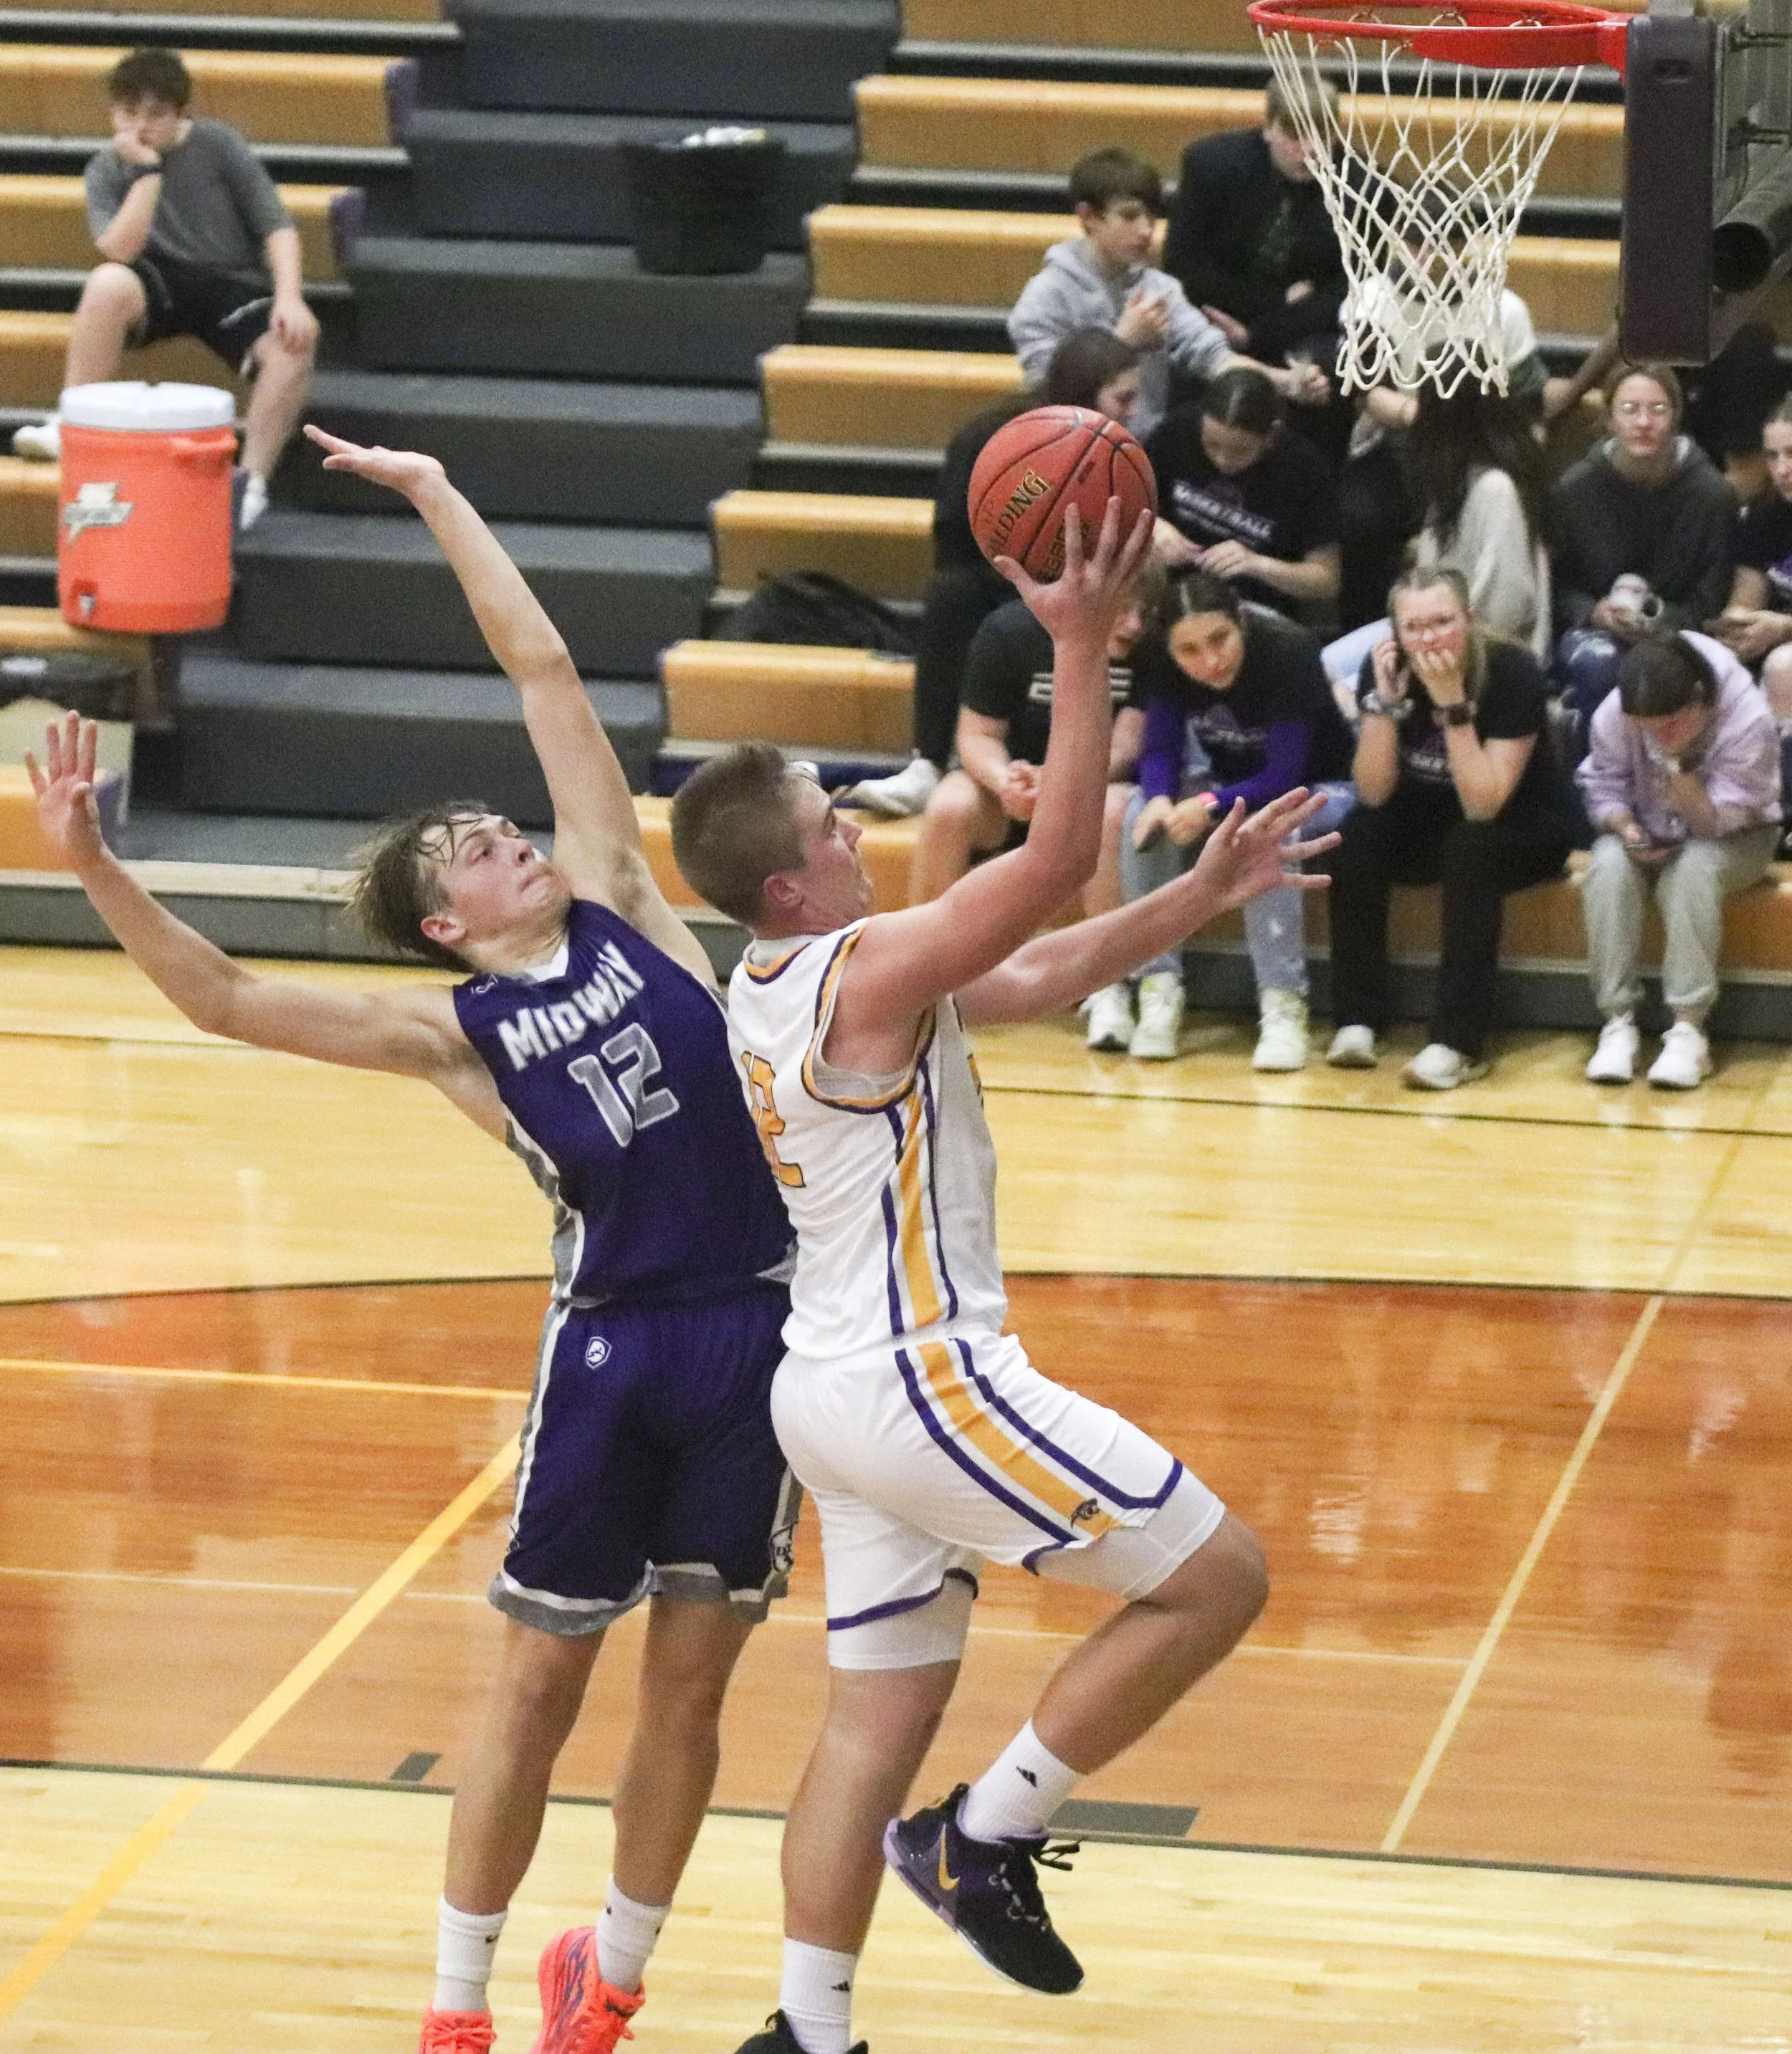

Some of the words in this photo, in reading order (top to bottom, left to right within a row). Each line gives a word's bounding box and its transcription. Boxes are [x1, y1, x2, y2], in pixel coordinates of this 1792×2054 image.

[985, 469, 1051, 554] ALDING
[497, 940, 645, 1072] MIDWAY
[567, 1022, 680, 1147] 12
